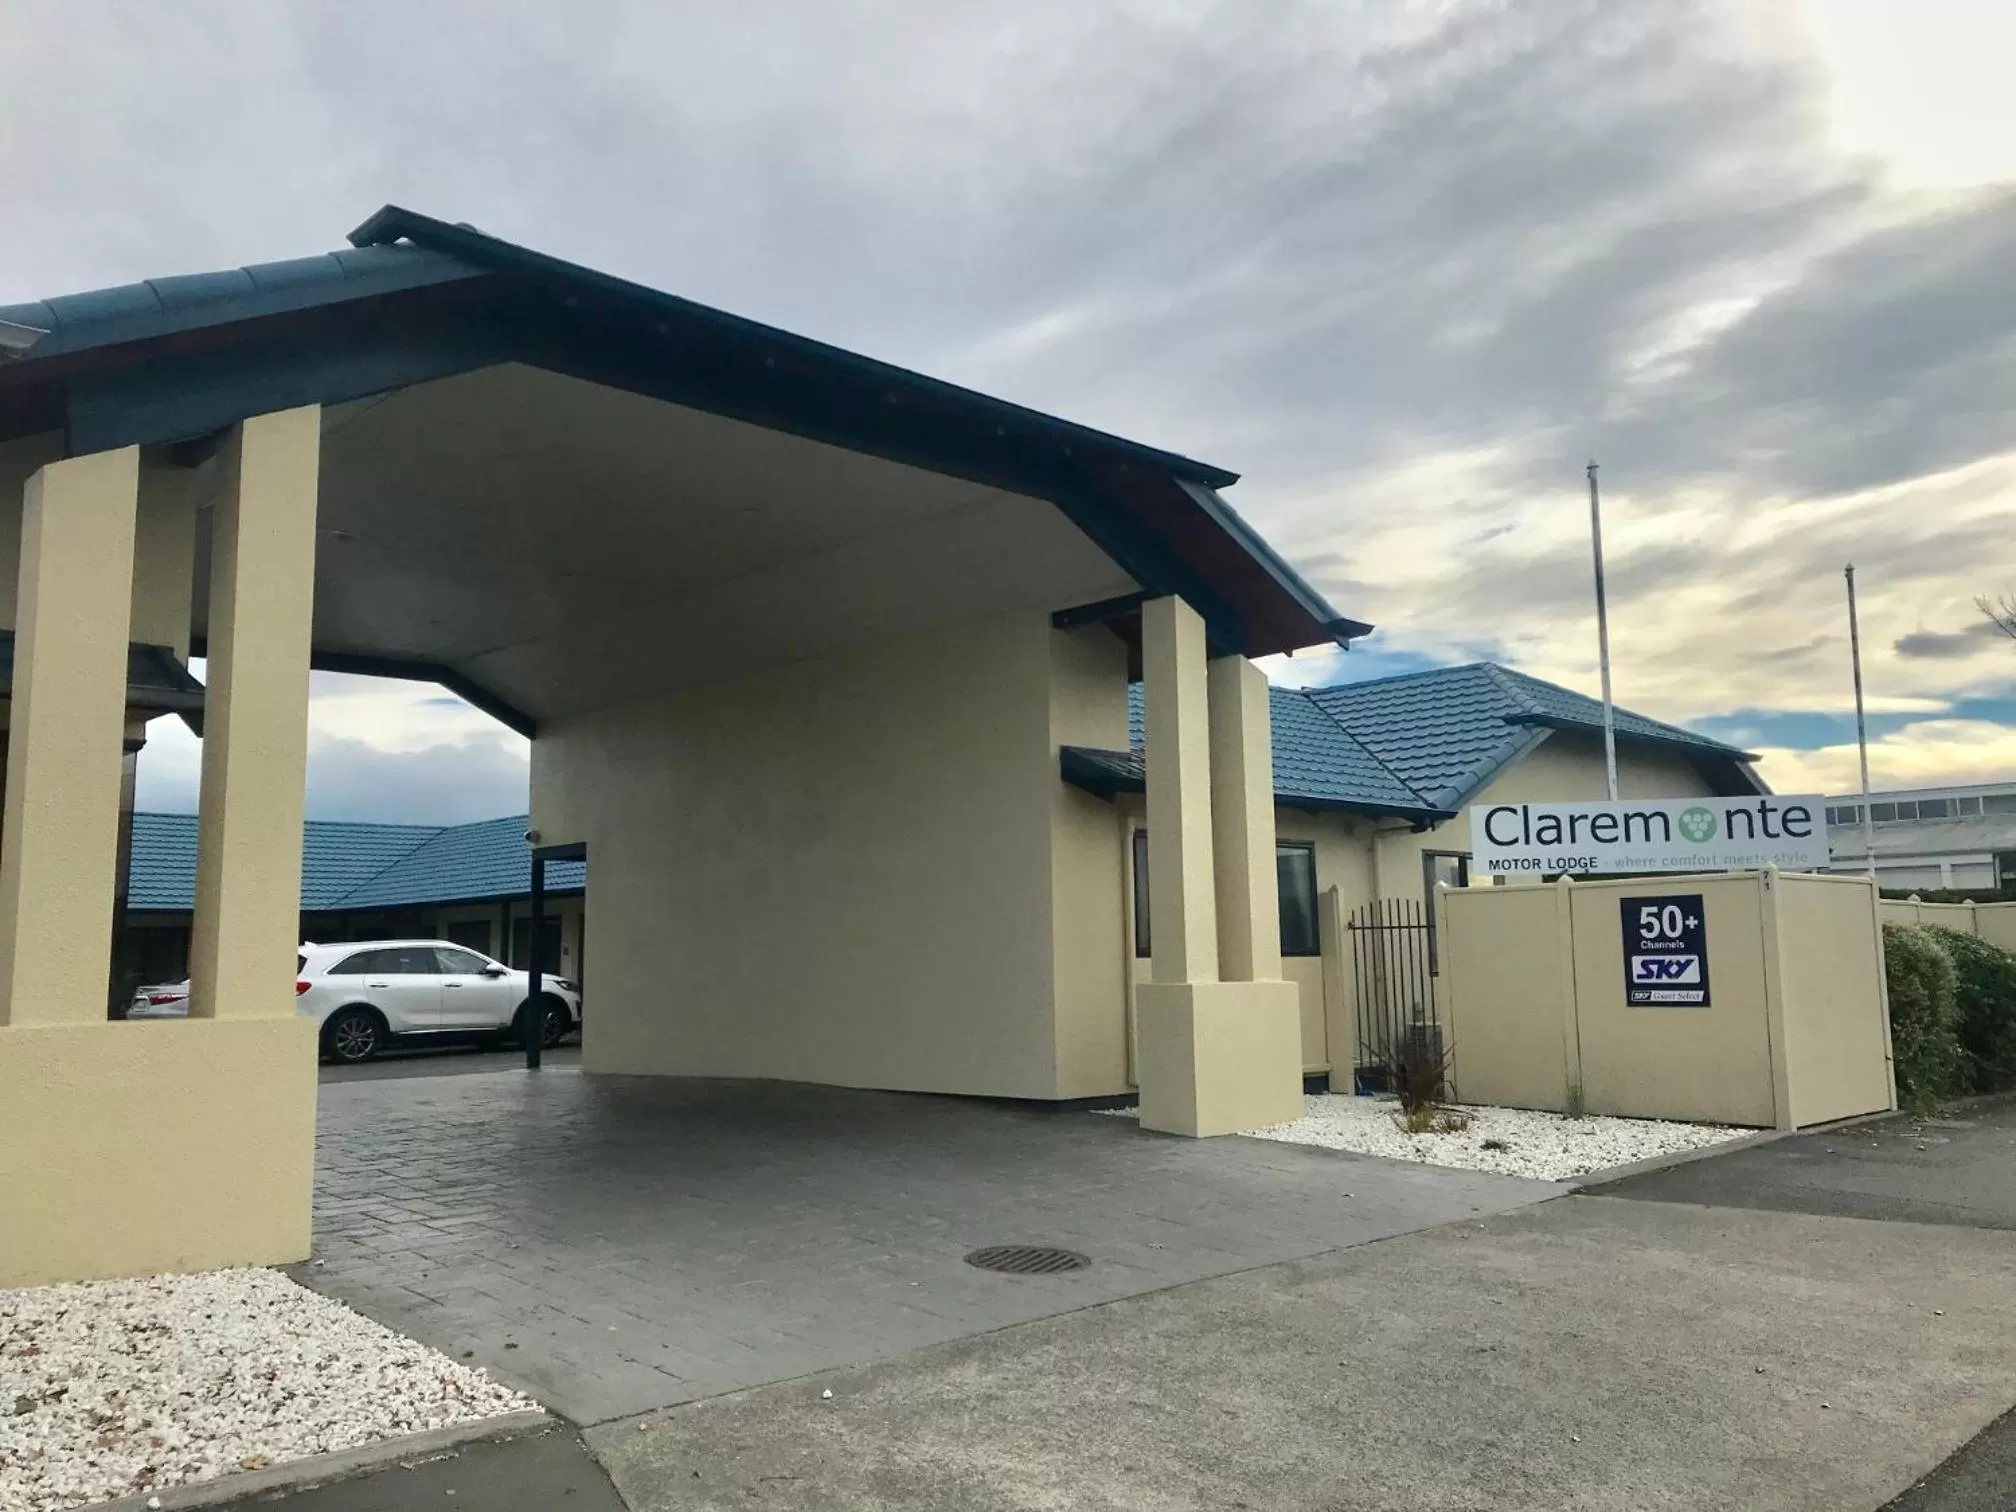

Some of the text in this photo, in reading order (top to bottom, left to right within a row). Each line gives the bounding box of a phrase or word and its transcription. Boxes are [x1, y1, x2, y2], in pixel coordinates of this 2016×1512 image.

[1488, 859, 1541, 871] MOTOR
[1547, 857, 1598, 869] LODGE
[1614, 856, 1657, 869] where
[1661, 853, 1718, 866] comfort
[1774, 850, 1809, 865] style
[1640, 905, 1698, 939] 50+
[1640, 940, 1685, 949] Channels
[1636, 959, 1696, 980] SKY
